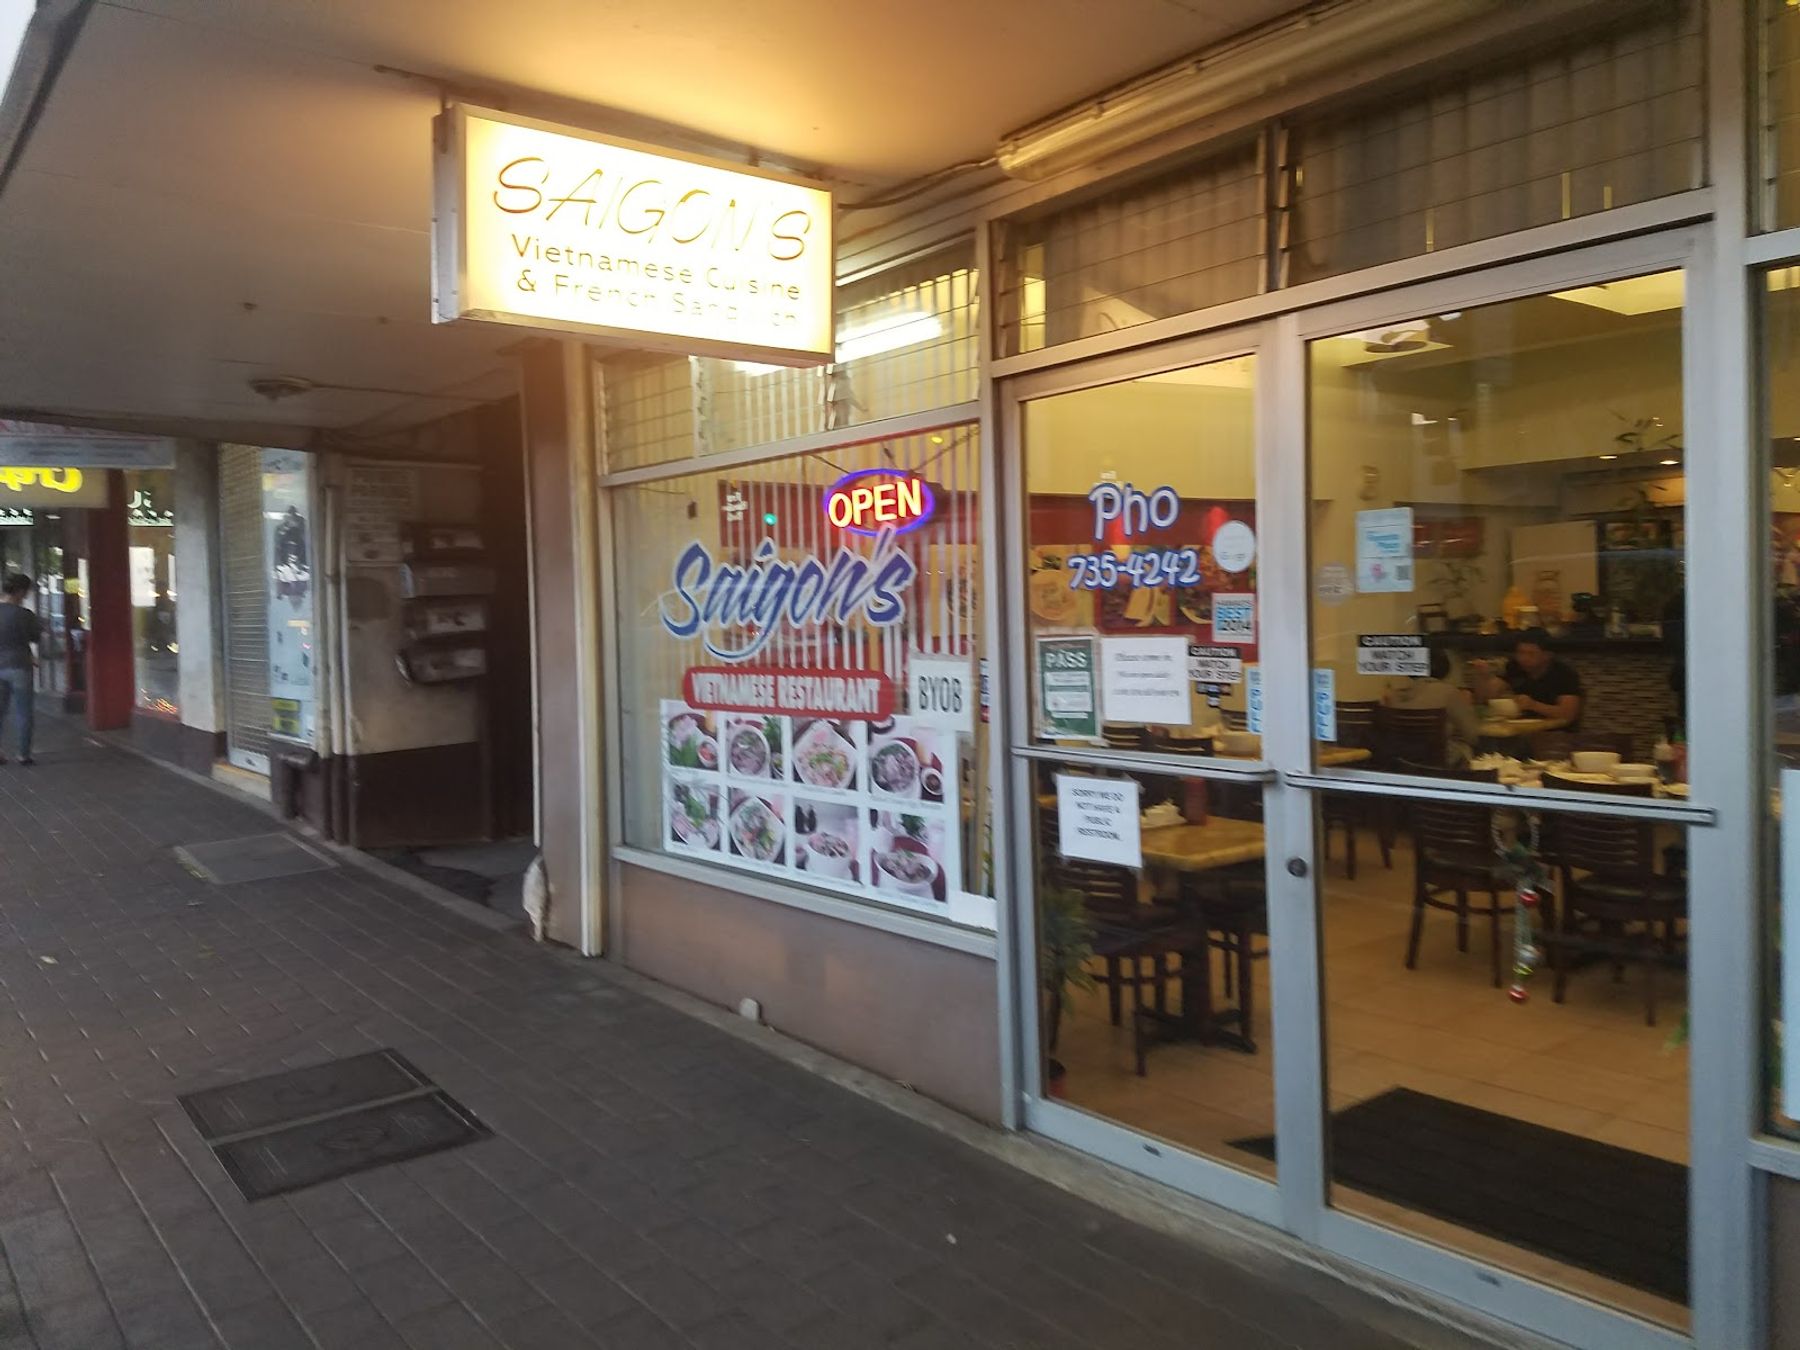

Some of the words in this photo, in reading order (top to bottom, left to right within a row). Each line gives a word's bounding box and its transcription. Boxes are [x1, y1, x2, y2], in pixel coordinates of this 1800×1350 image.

[493, 156, 812, 262] SAIGONS
[511, 233, 692, 284] Vietnamese
[706, 267, 801, 301] Cusne
[517, 269, 537, 292] &
[829, 478, 922, 528] OPEN
[1067, 547, 1201, 589] 735-4242
[660, 523, 916, 663] Saigon's
[1045, 651, 1088, 669] PASS
[690, 672, 776, 708] VIETNAMESE
[777, 675, 881, 714] RESTAURANT
[918, 675, 963, 713] BYOB
